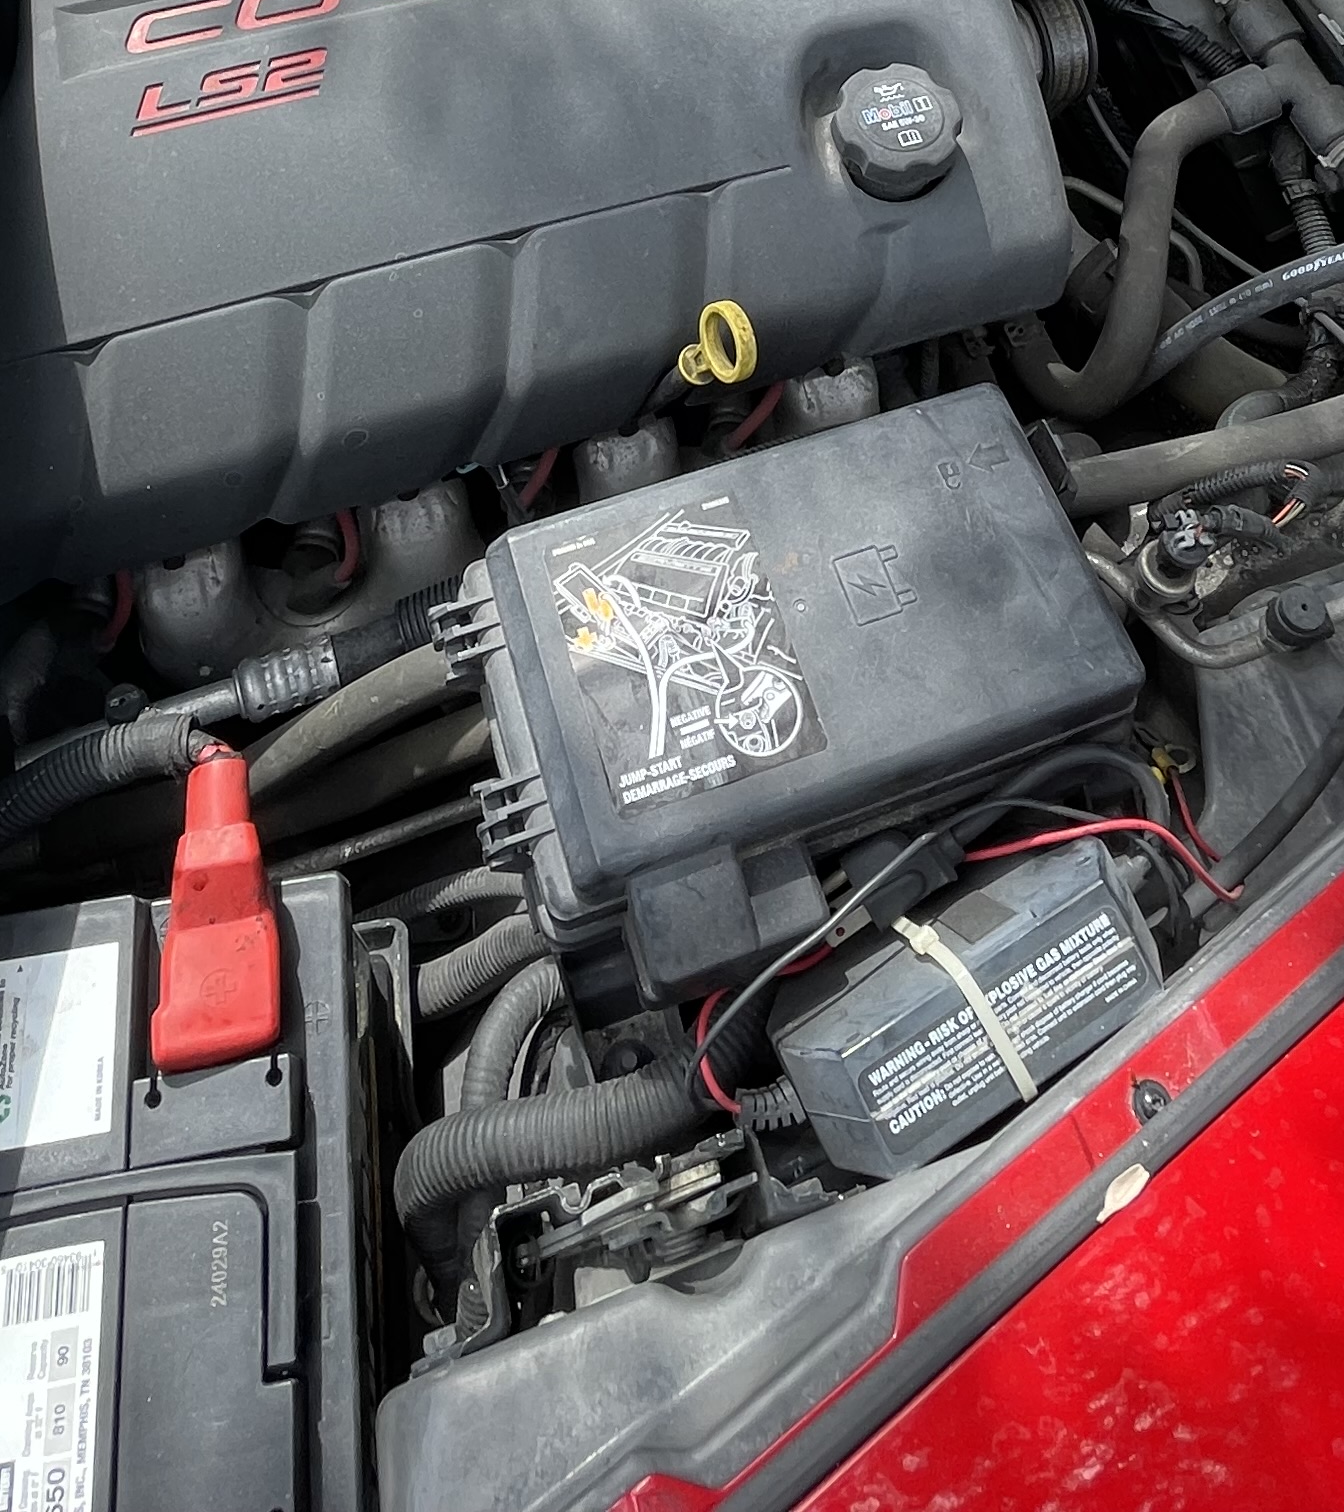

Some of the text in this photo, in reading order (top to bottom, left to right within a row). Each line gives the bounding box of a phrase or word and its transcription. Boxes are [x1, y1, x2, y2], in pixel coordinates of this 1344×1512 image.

[134, 46, 328, 126] LS2
[861, 100, 914, 125] Mobil
[669, 705, 712, 728] NEGATIVE
[619, 755, 683, 789] JUMP-START
[925, 1016, 961, 1046] RISK
[982, 962, 1039, 1006] XPLOSIVE
[1032, 945, 1063, 973] GAS
[888, 1089, 948, 1135] CAUTION:
[209, 1219, 231, 1309] 24029A2
[57, 1346, 69, 1367] 90
[53, 1404, 66, 1436] 810
